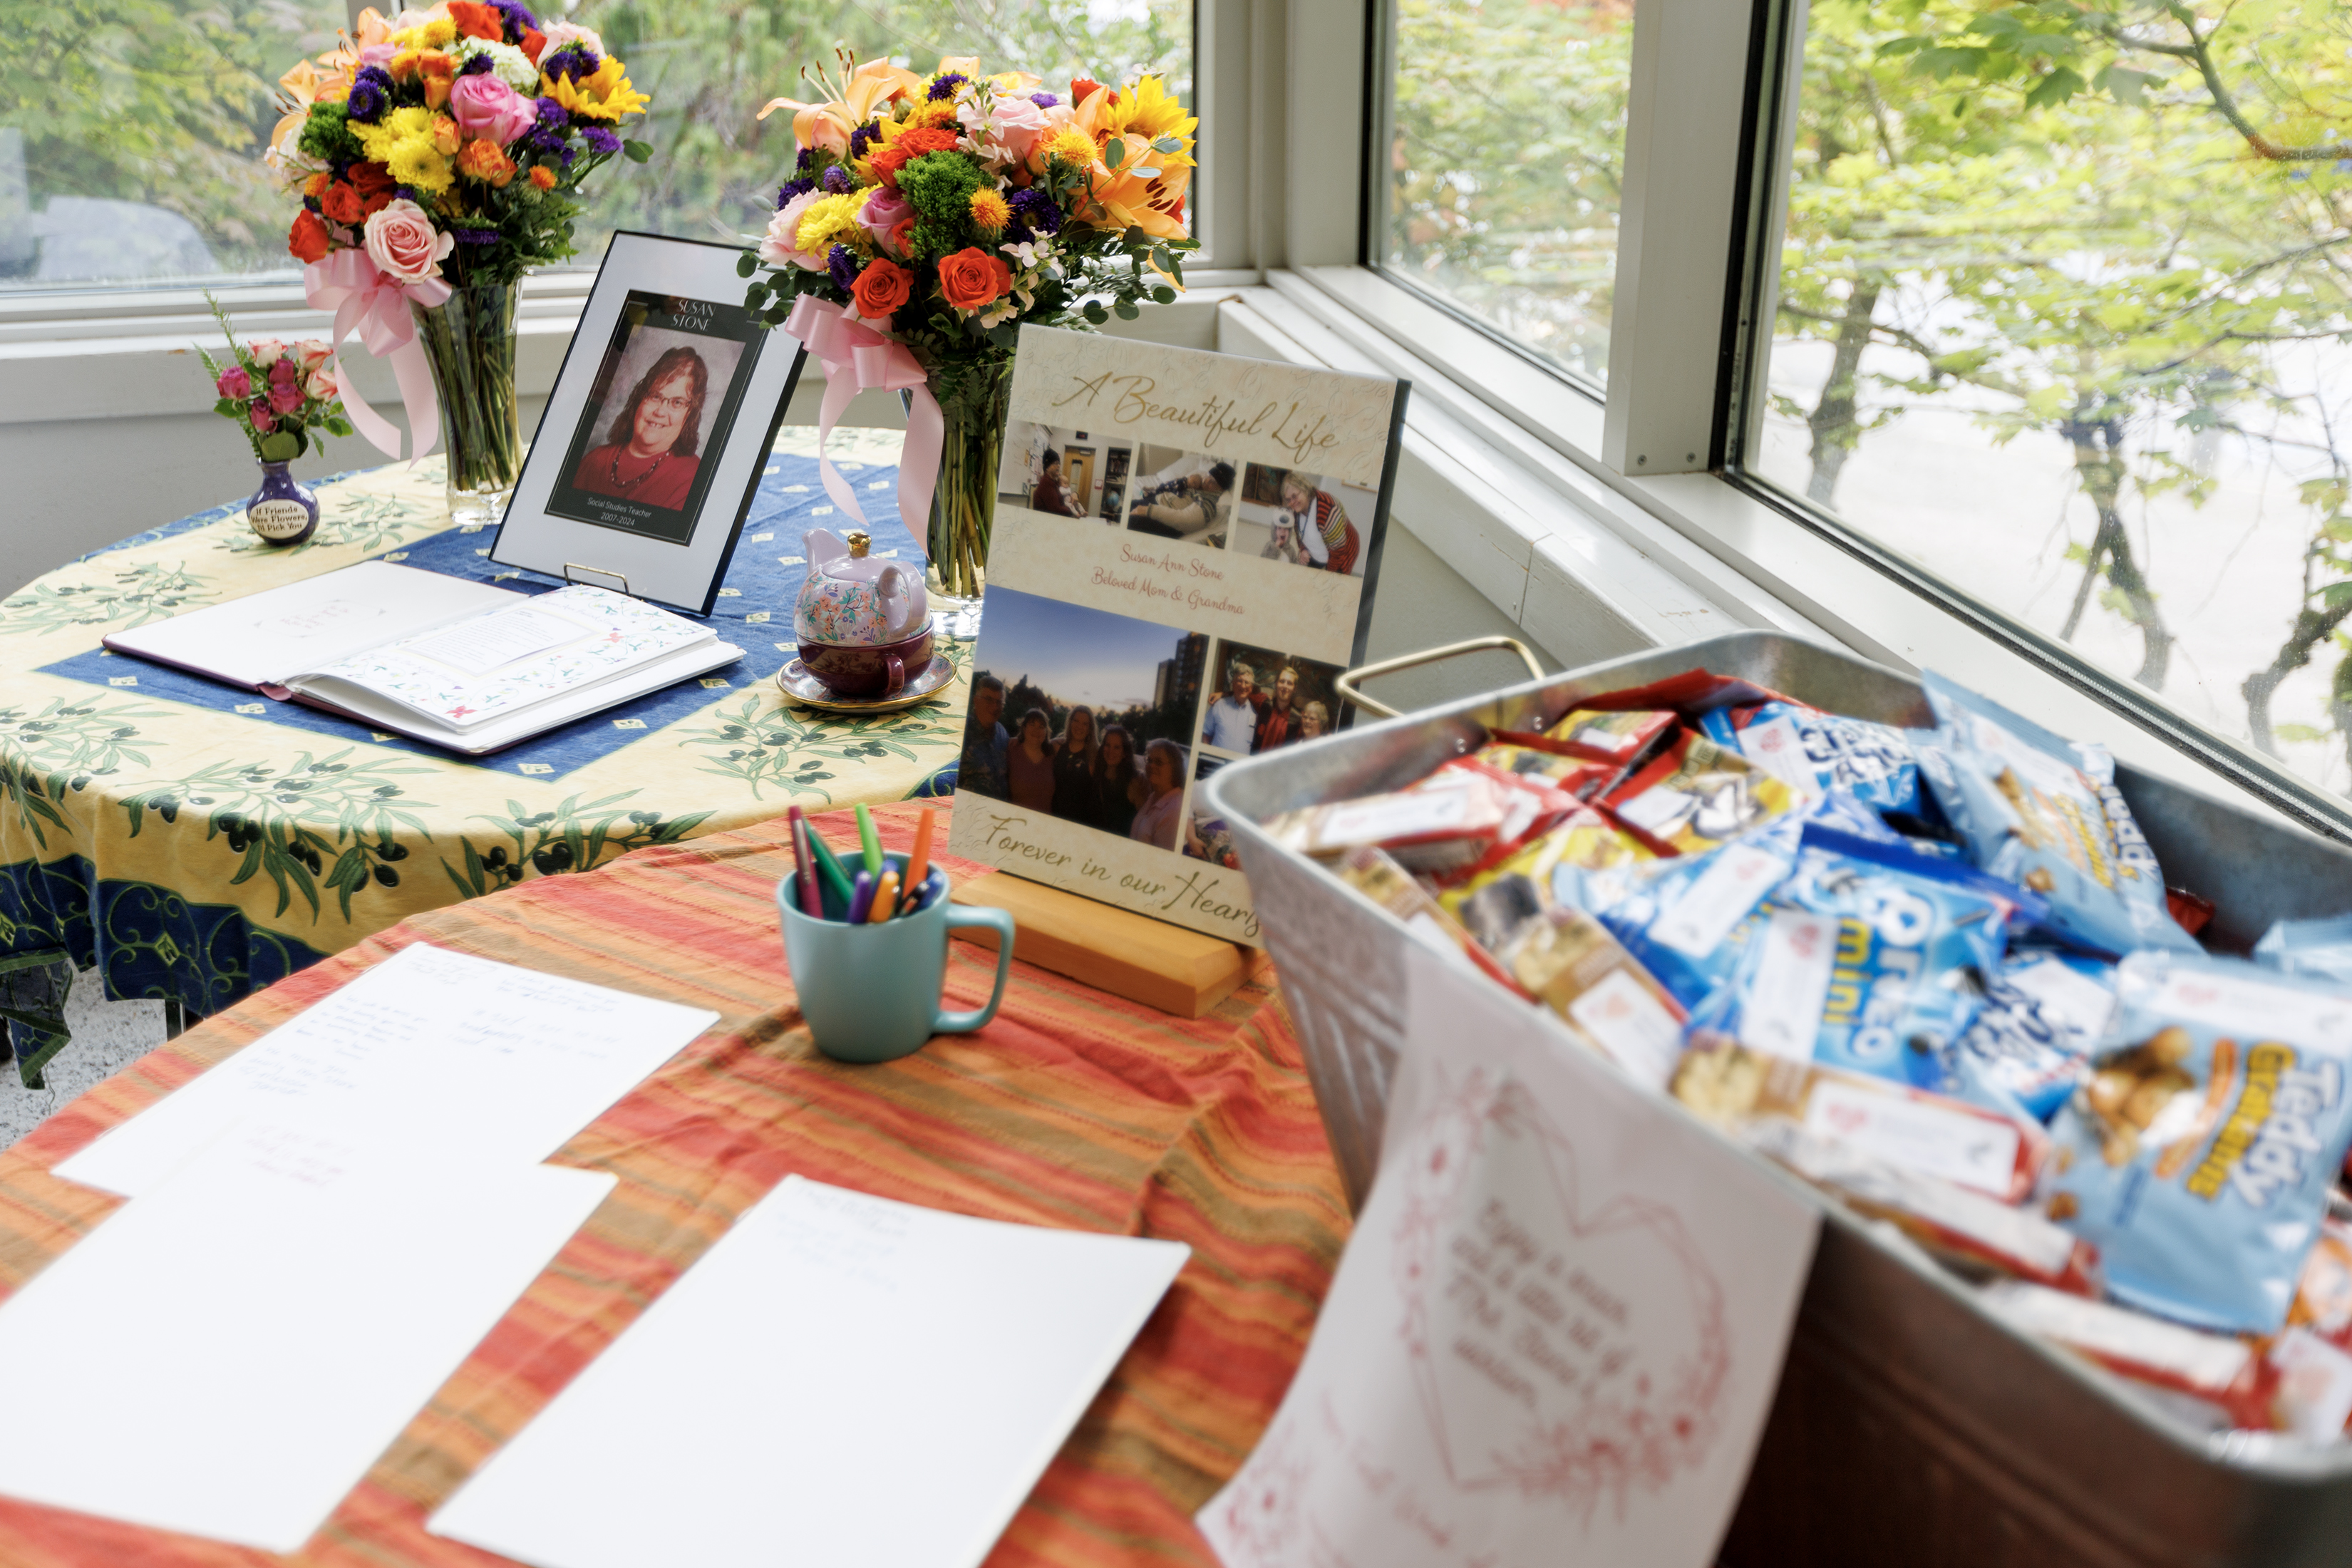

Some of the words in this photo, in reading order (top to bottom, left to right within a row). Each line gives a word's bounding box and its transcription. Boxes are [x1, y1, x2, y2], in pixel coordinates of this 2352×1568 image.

[671, 314, 711, 331] STONE
[678, 299, 716, 316] SUSAN
[1051, 371, 1113, 406] A
[1113, 375, 1277, 448] Beautiful
[1272, 401, 1340, 465] Life
[265, 505, 297, 515] Friends
[587, 497, 605, 507] Social
[605, 501, 626, 512] Studies
[629, 506, 651, 518] Teacher
[601, 512, 635, 525] 2007-2024
[1120, 544, 1157, 565] Susan
[1157, 553, 1186, 572] Ann
[1188, 558, 1224, 580] Stone
[1091, 567, 1138, 590] Beloved
[1138, 578, 1168, 597] Mom
[1171, 586, 1183, 601] &
[1187, 589, 1245, 614] Grandma
[986, 814, 1071, 866] Forever
[1081, 857, 1111, 880] in
[1120, 874, 1167, 897] our
[1823, 917, 1871, 1024] mini
[2229, 1061, 2341, 1206] Teddy
